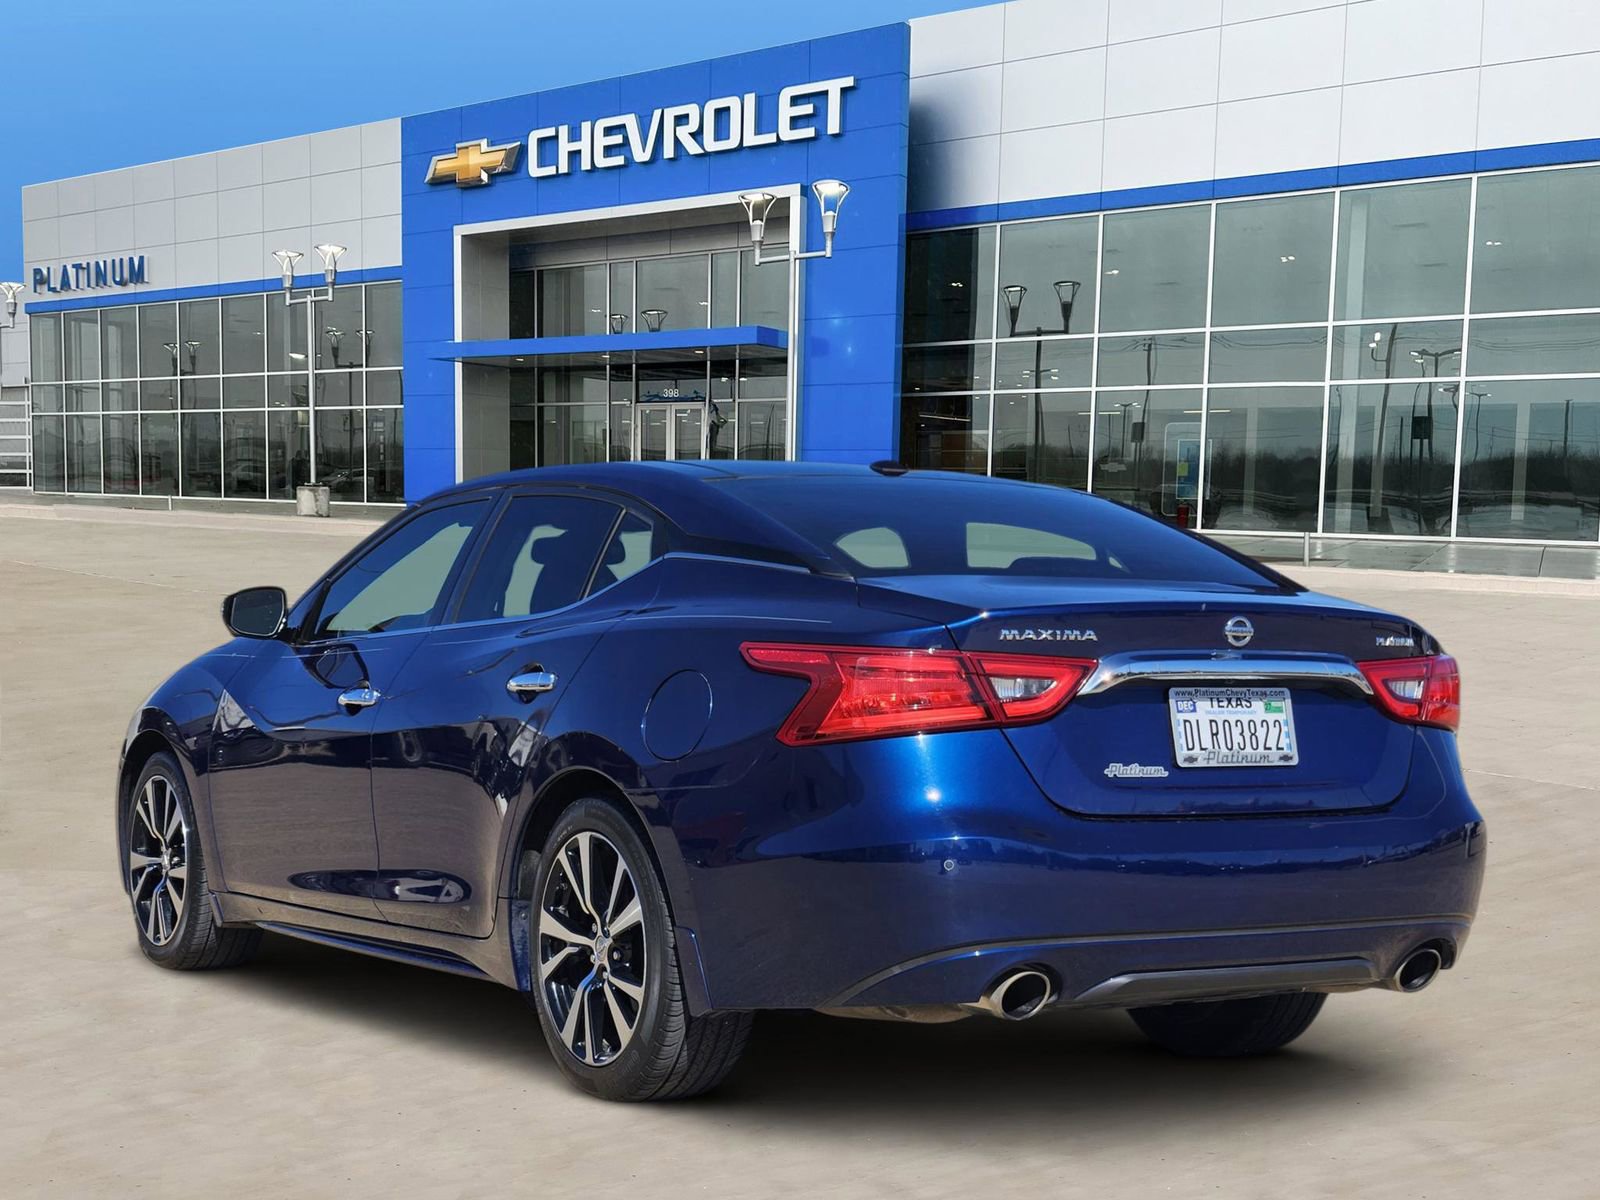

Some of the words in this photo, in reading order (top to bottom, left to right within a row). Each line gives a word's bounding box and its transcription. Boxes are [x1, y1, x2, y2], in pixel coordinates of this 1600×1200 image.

[527, 75, 856, 179] CHEVROLET
[32, 255, 147, 294] PLATINUM
[663, 388, 680, 398] 398
[999, 629, 1098, 640] MAXIMA
[1174, 689, 1286, 698] www.PlatinumChevyTexas.com
[1177, 701, 1194, 711] DEC
[1210, 697, 1252, 709] TEXAS
[1183, 719, 1284, 751] DLR03822
[1203, 750, 1275, 764] Platinum
[1104, 763, 1169, 777] Platinum
